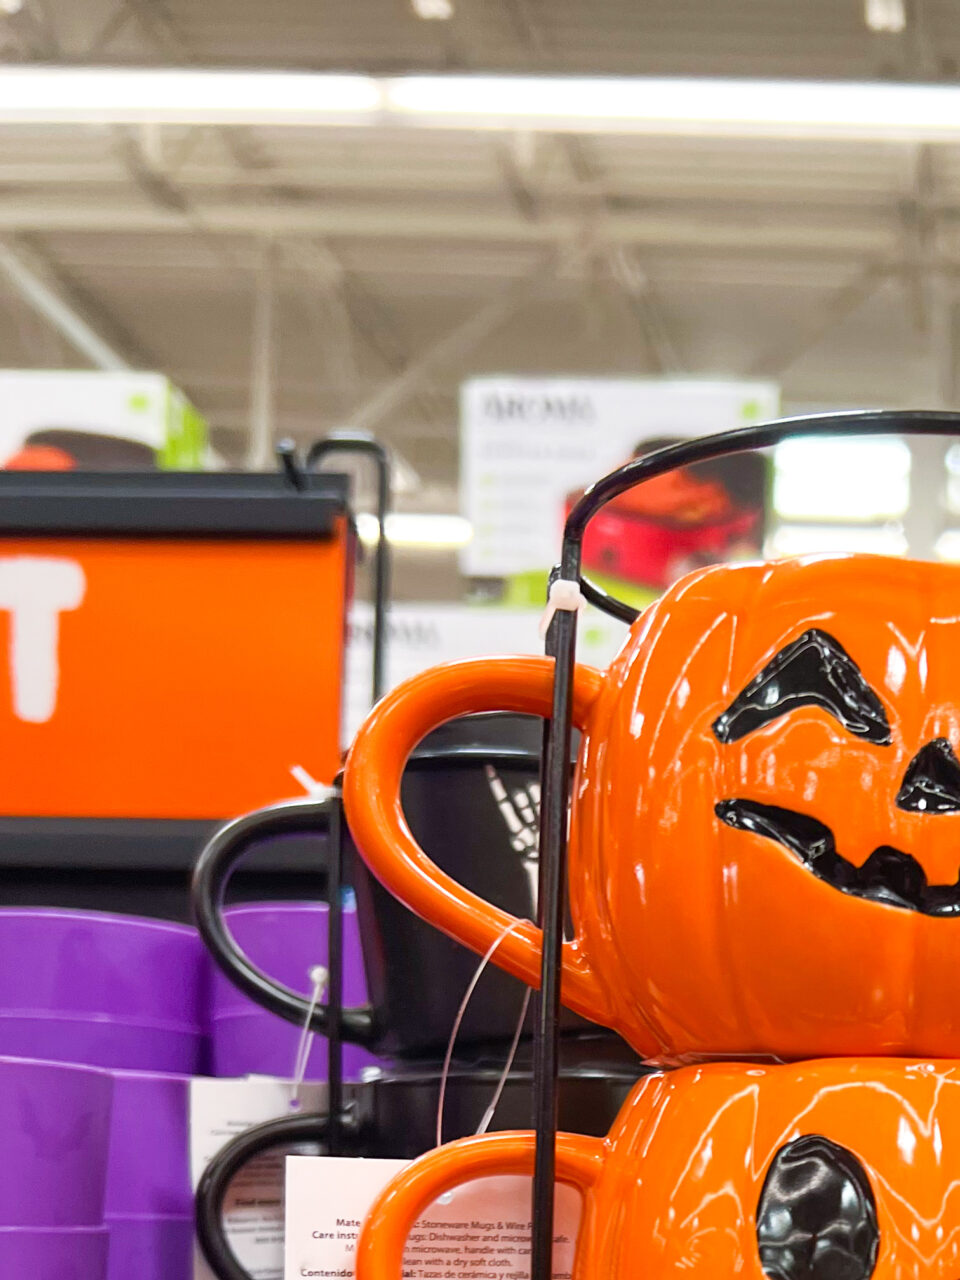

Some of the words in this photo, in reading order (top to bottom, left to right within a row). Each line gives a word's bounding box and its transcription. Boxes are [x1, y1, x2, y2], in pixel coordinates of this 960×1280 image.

[422, 1220, 469, 1229] Stoneware
[471, 1221, 495, 1232] Mugs
[497, 1221, 503, 1229] &
[505, 1222, 525, 1230] Wire
[312, 1230, 334, 1239] Care
[408, 1234, 426, 1243] ugs:
[429, 1232, 480, 1241] Dishwasher
[482, 1234, 499, 1242] and
[464, 1245, 494, 1254] handle
[424, 1258, 443, 1266] with
[453, 1258, 467, 1268] dry
[470, 1258, 486, 1266] soft
[488, 1258, 513, 1267] cloth.
[300, 1268, 353, 1277] Contenido
[417, 1269, 442, 1278] Tazas
[444, 1270, 456, 1278] de
[457, 1270, 497, 1279] cerámica
[498, 1273, 504, 1280] y
[506, 1271, 529, 1280] rejilla
